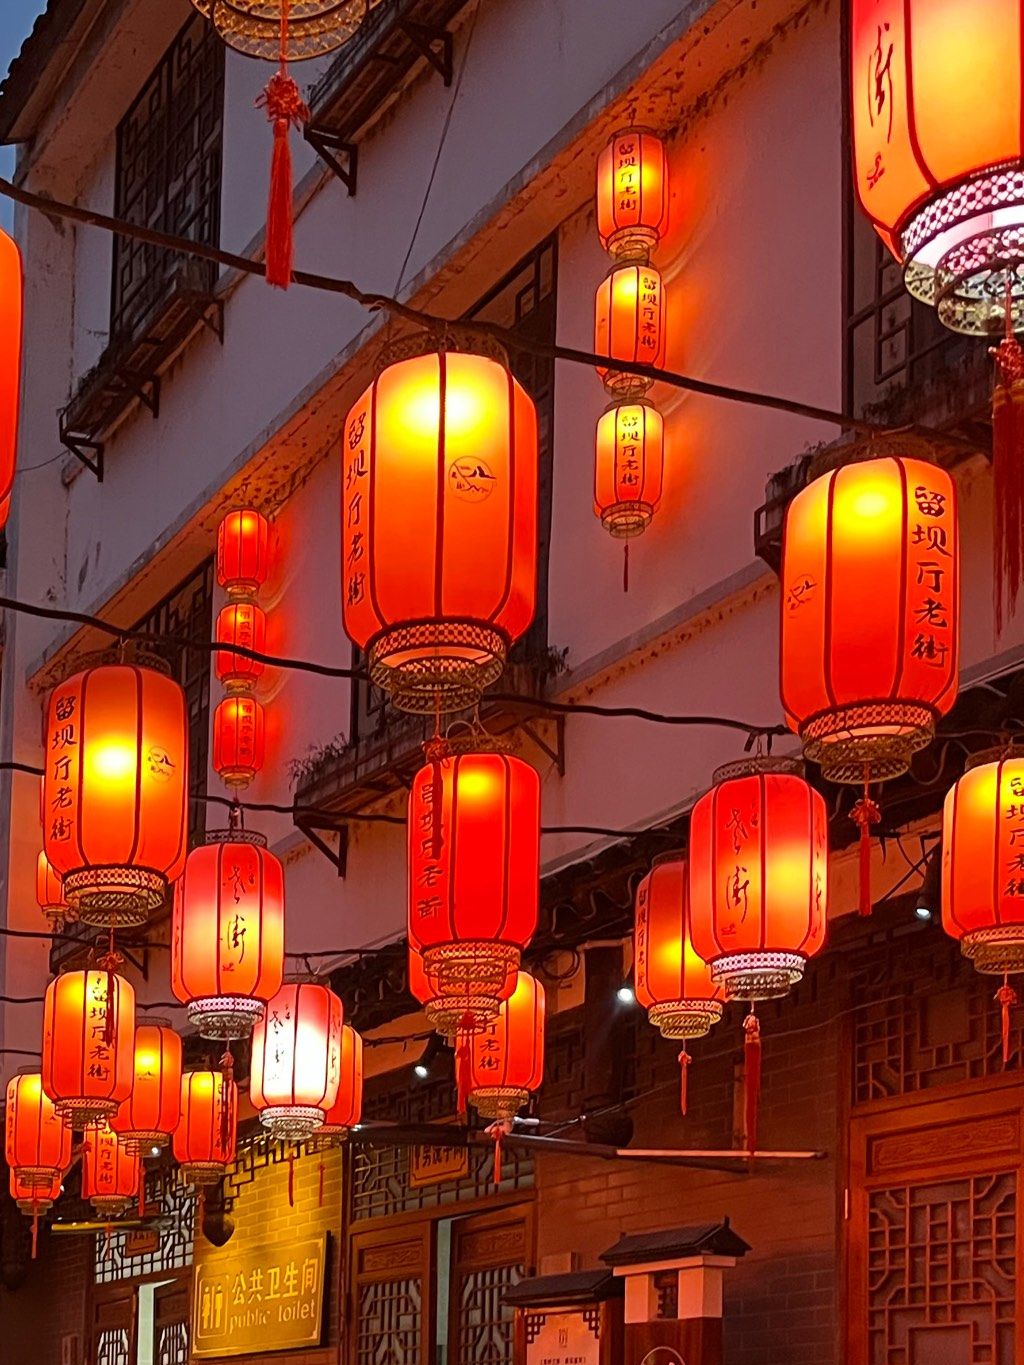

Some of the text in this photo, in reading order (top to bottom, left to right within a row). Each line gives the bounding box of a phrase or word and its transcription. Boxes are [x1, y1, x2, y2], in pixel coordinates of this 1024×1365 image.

[618, 143, 637, 211] 留坝厅老街
[641, 276, 658, 350] 留坝厅老街
[620, 415, 641, 487] 留坝厅老街
[347, 411, 368, 608] 留坝厅老街
[910, 485, 953, 669] 留坝厅老街
[50, 695, 77, 842] 留坝厅老街
[87, 985, 111, 1081] 留坝厅老街
[229, 1299, 315, 1334] public toilet
[232, 1257, 319, 1305] 公共卫生间
